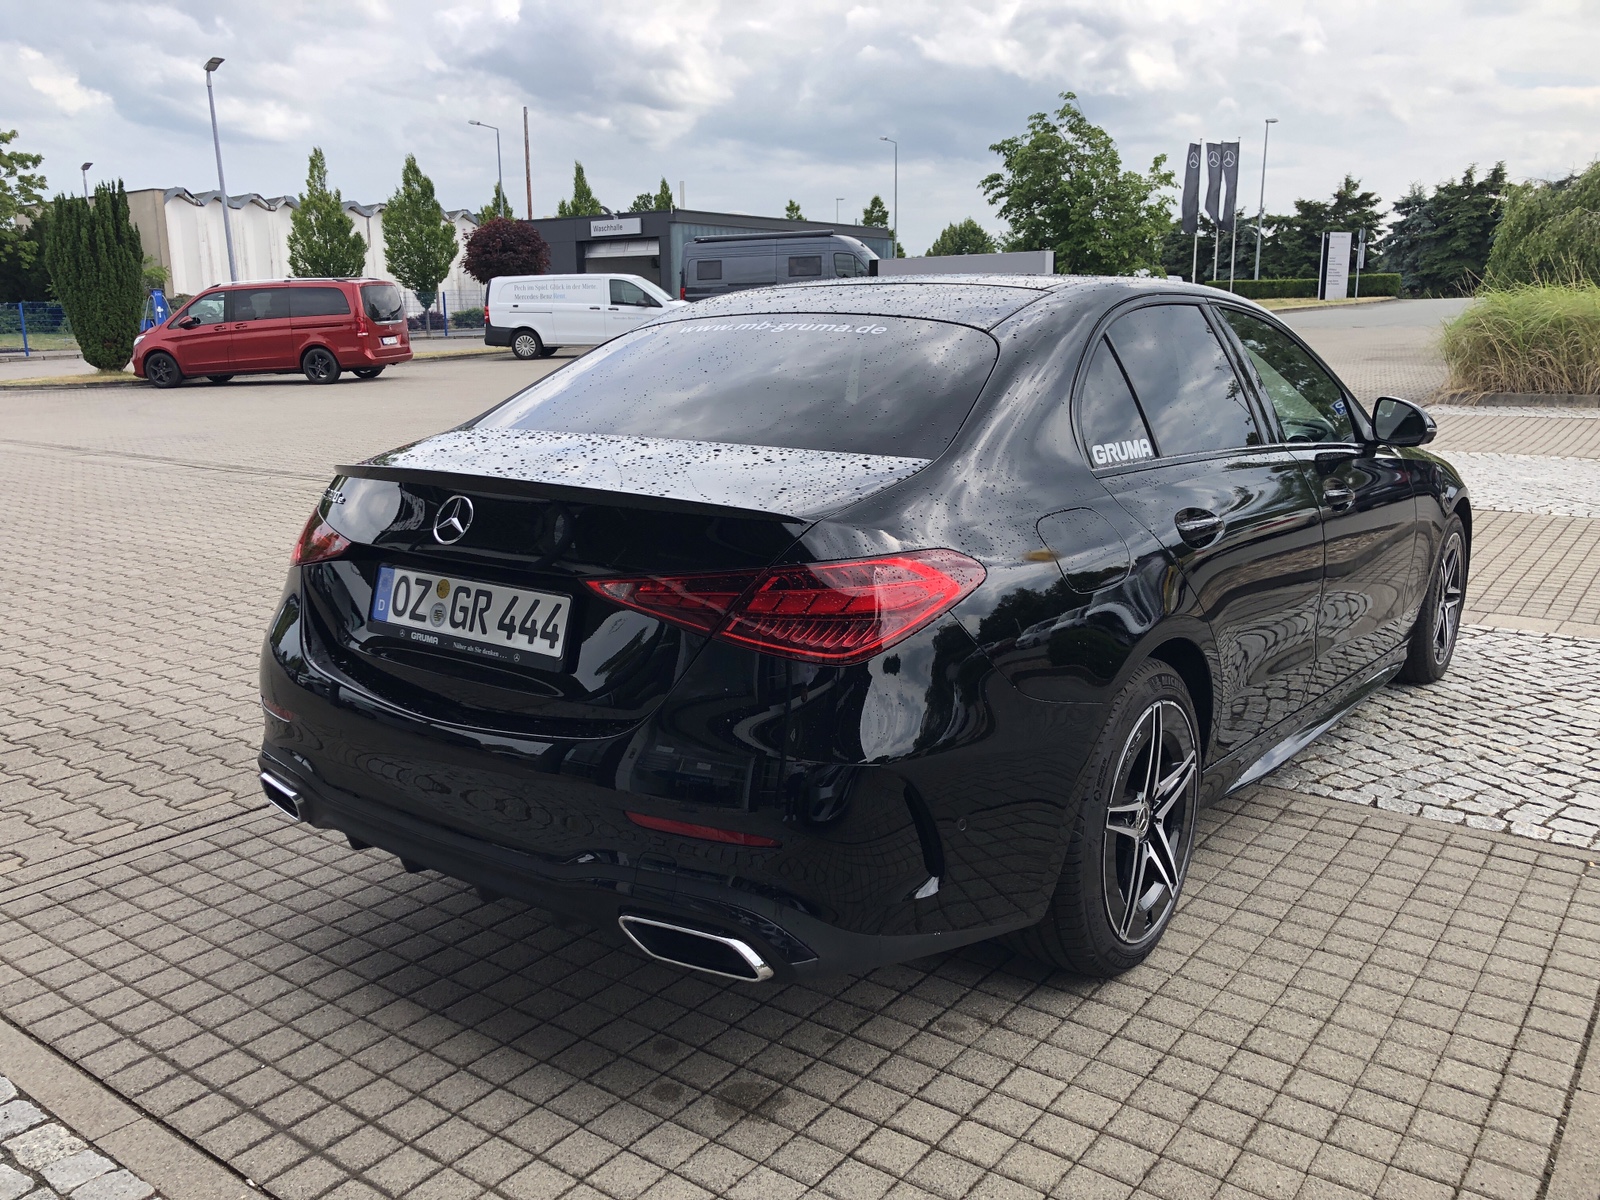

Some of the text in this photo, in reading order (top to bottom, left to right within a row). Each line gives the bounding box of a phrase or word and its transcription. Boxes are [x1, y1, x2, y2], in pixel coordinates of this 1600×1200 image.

[593, 224, 623, 232] Waschhalle
[679, 321, 887, 335] www.mb-gruma.de
[1092, 438, 1153, 465] GRUMA
[377, 599, 386, 611] D
[392, 575, 562, 649] OZ GR 444
[410, 631, 439, 645] GRUMA
[453, 641, 467, 651] Näher
[474, 645, 482, 653] Sie
[1096, 757, 1107, 787] MICHELIN
